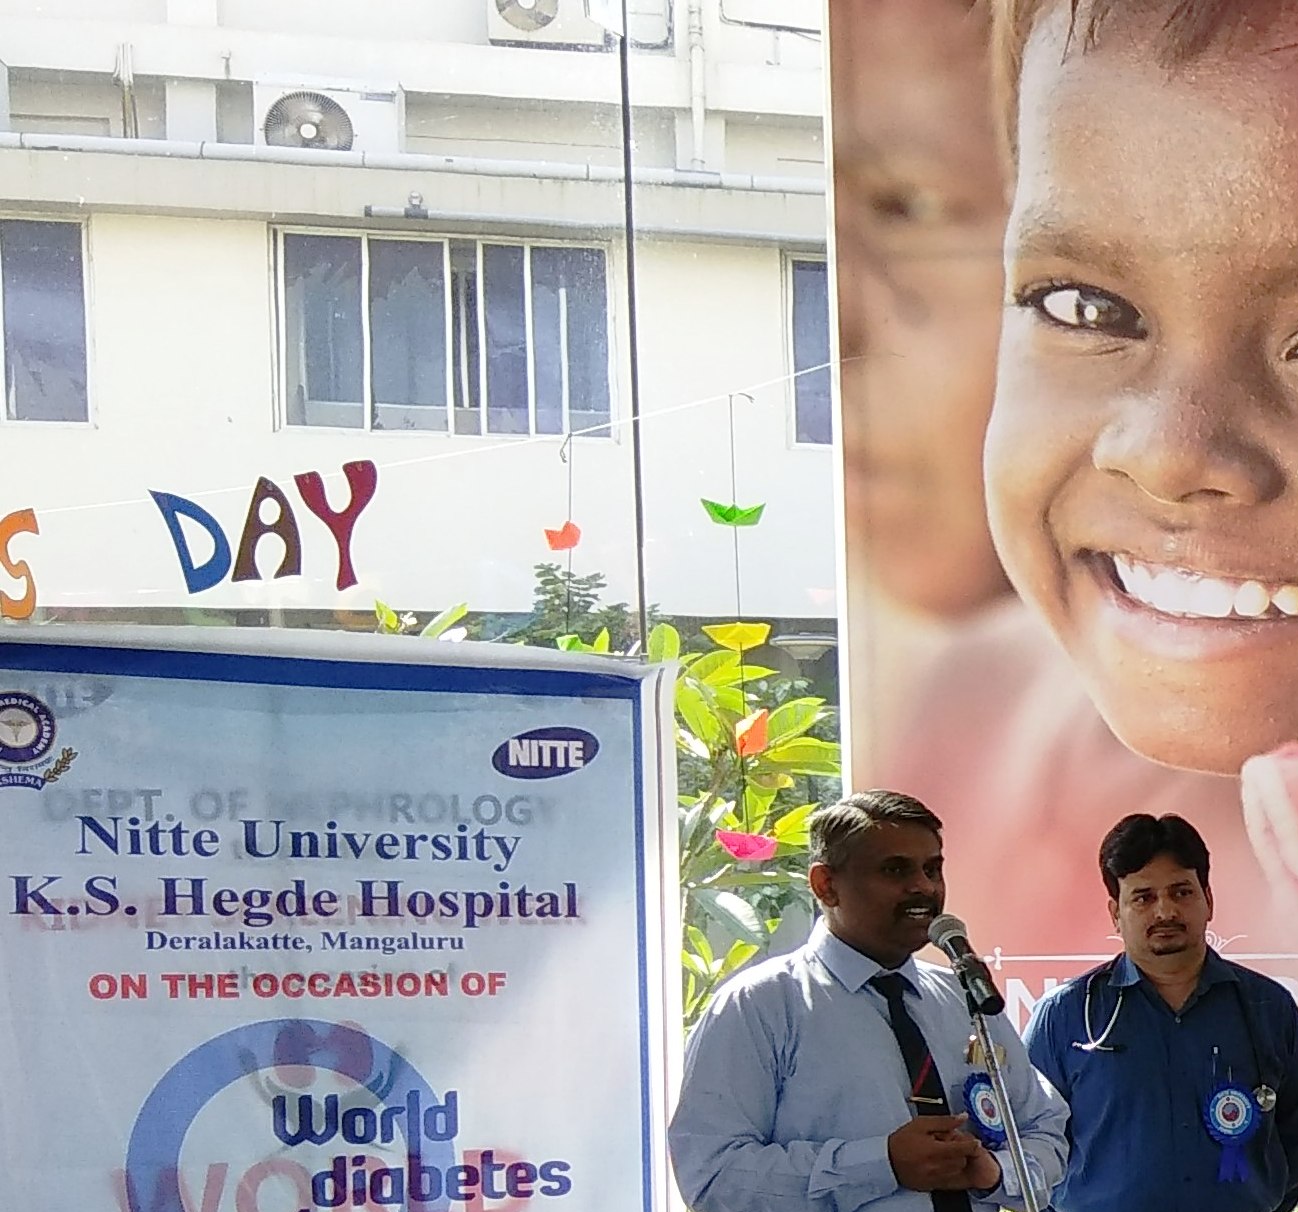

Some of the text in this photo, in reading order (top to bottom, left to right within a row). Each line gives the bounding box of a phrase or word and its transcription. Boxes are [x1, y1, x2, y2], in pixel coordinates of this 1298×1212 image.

[147, 459, 377, 594] DAY
[508, 738, 585, 768] NITTE
[74, 815, 522, 872] Nitte University
[8, 875, 138, 916] K.S.
[157, 877, 338, 928] Hegde
[355, 879, 581, 929] Hospital
[144, 930, 465, 956] Deralakatte, Mangaluru
[88, 973, 148, 1000] ON
[160, 973, 240, 1000] THE
[251, 972, 449, 999] OCCASION
[460, 972, 508, 997] OF
[270, 1089, 459, 1147] World
[310, 1149, 573, 1209] diabetes
